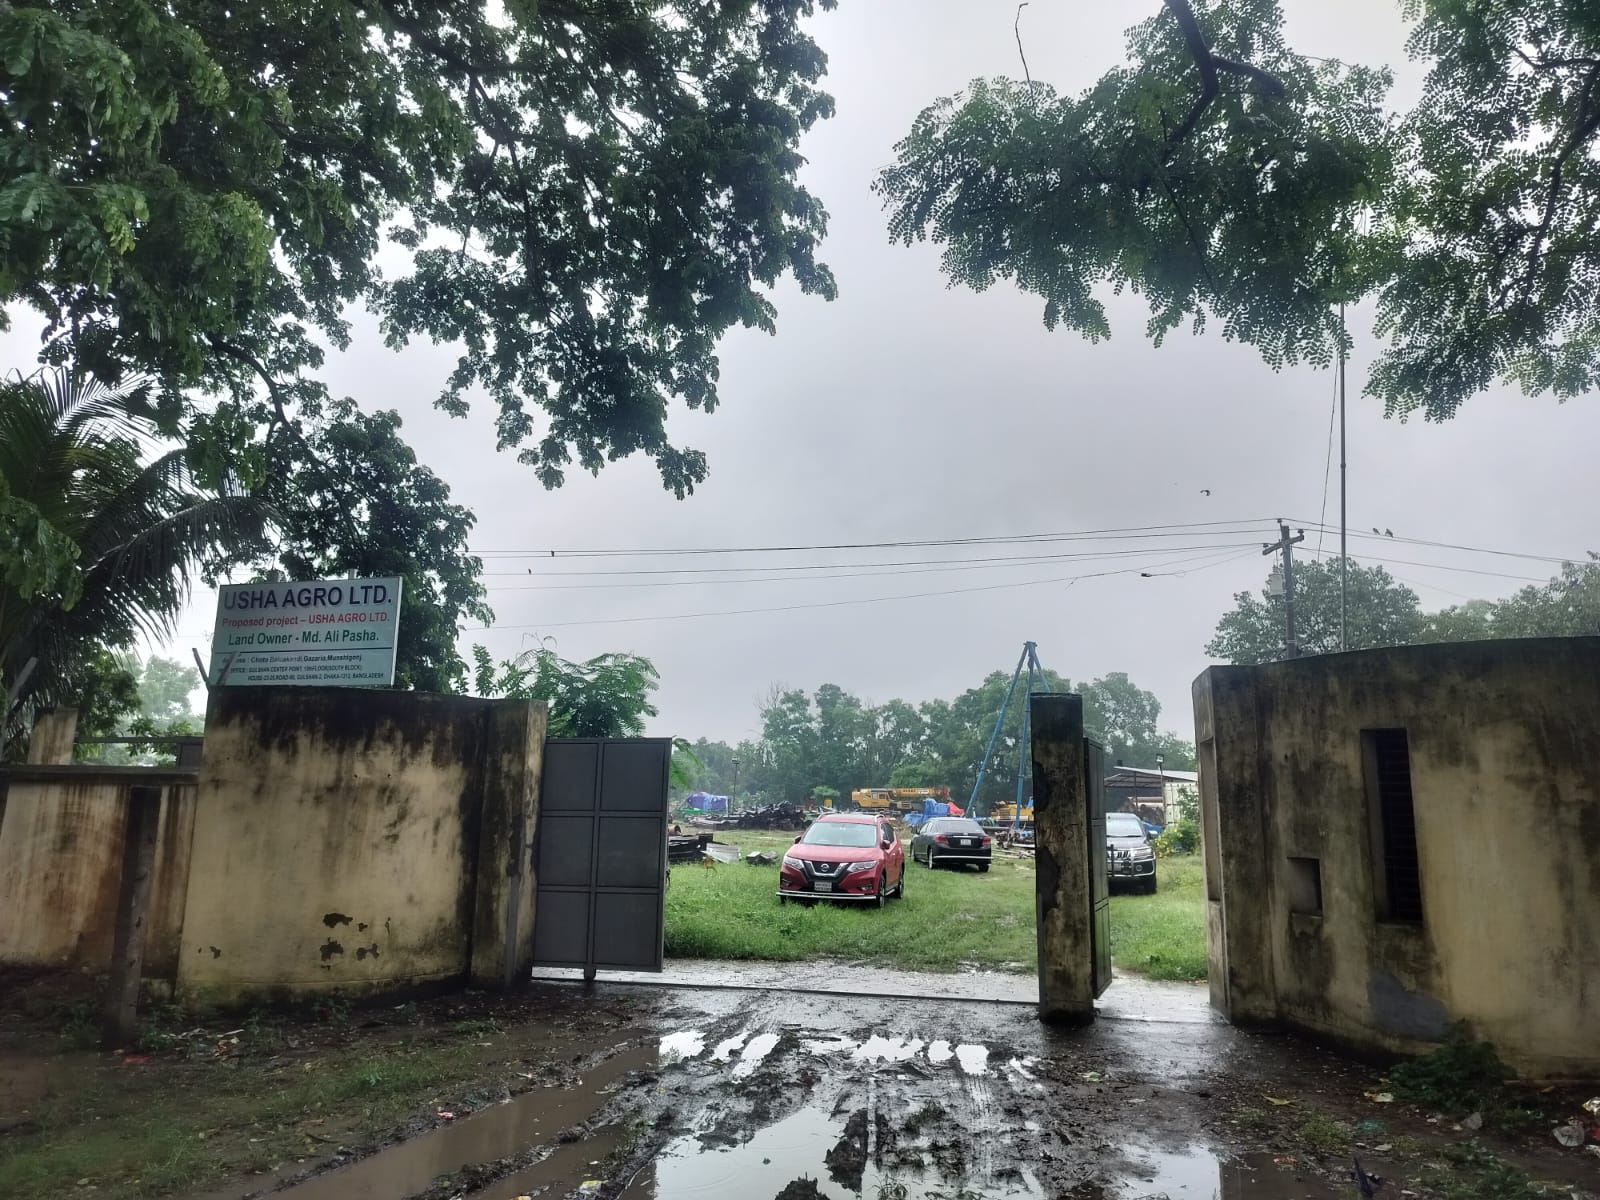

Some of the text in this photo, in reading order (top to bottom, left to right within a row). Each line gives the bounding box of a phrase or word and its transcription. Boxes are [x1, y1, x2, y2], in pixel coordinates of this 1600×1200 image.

[224, 585, 392, 610] USHA AGRO LTD.
[223, 617, 264, 629] Proposed
[266, 616, 298, 628] project
[309, 614, 336, 625] USHA
[338, 612, 367, 623] AGRO
[369, 611, 390, 622] LTD.
[228, 633, 255, 646] Land
[257, 632, 293, 645] Owner
[302, 631, 321, 643] Md.
[324, 630, 339, 642] Ali
[342, 629, 379, 642] Pasha.
